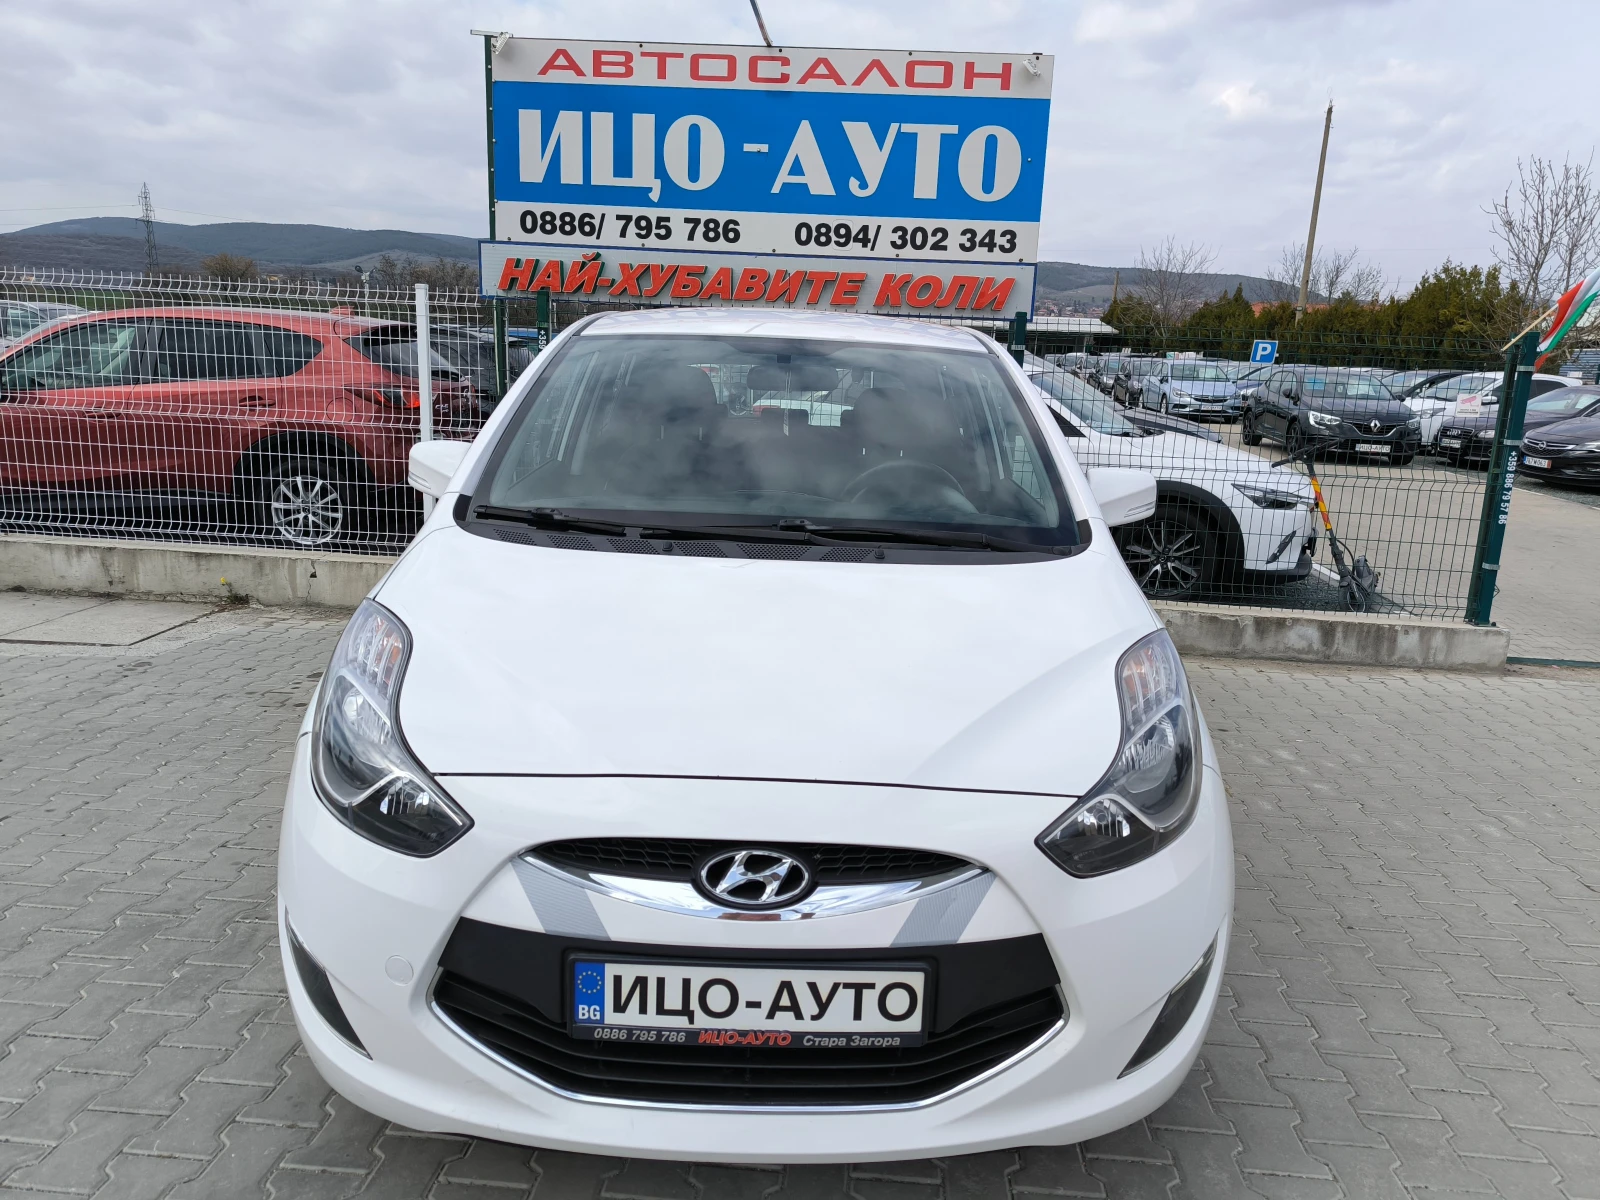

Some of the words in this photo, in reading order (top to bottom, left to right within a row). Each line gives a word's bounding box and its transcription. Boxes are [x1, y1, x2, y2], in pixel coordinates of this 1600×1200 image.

[537, 48, 1013, 91] АВТОСАЛОН
[519, 209, 606, 240] 0886/
[615, 214, 673, 241] 795
[683, 217, 742, 244] 786
[794, 221, 882, 251] 0894/
[890, 225, 949, 252] 302
[958, 227, 1018, 254] 343
[497, 251, 867, 305] НАЙ-ХУБАВИТЕ
[873, 272, 1016, 311] КОЛИ
[1255, 343, 1272, 361] P
[1507, 450, 1517, 472] +359
[1504, 473, 1514, 489] 886
[1502, 490, 1512, 501] 79
[1500, 502, 1510, 513] 57
[1498, 514, 1508, 525] 86
[612, 974, 919, 1026] ИЦО-АУТО
[578, 1004, 601, 1020] BG
[593, 1027, 628, 1040] 0886
[631, 1030, 657, 1042] 795
[661, 1031, 687, 1043] 786
[698, 1030, 792, 1046] ИЦО-АУТО
[803, 1035, 847, 1047] Стара
[850, 1035, 901, 1048] Загора
